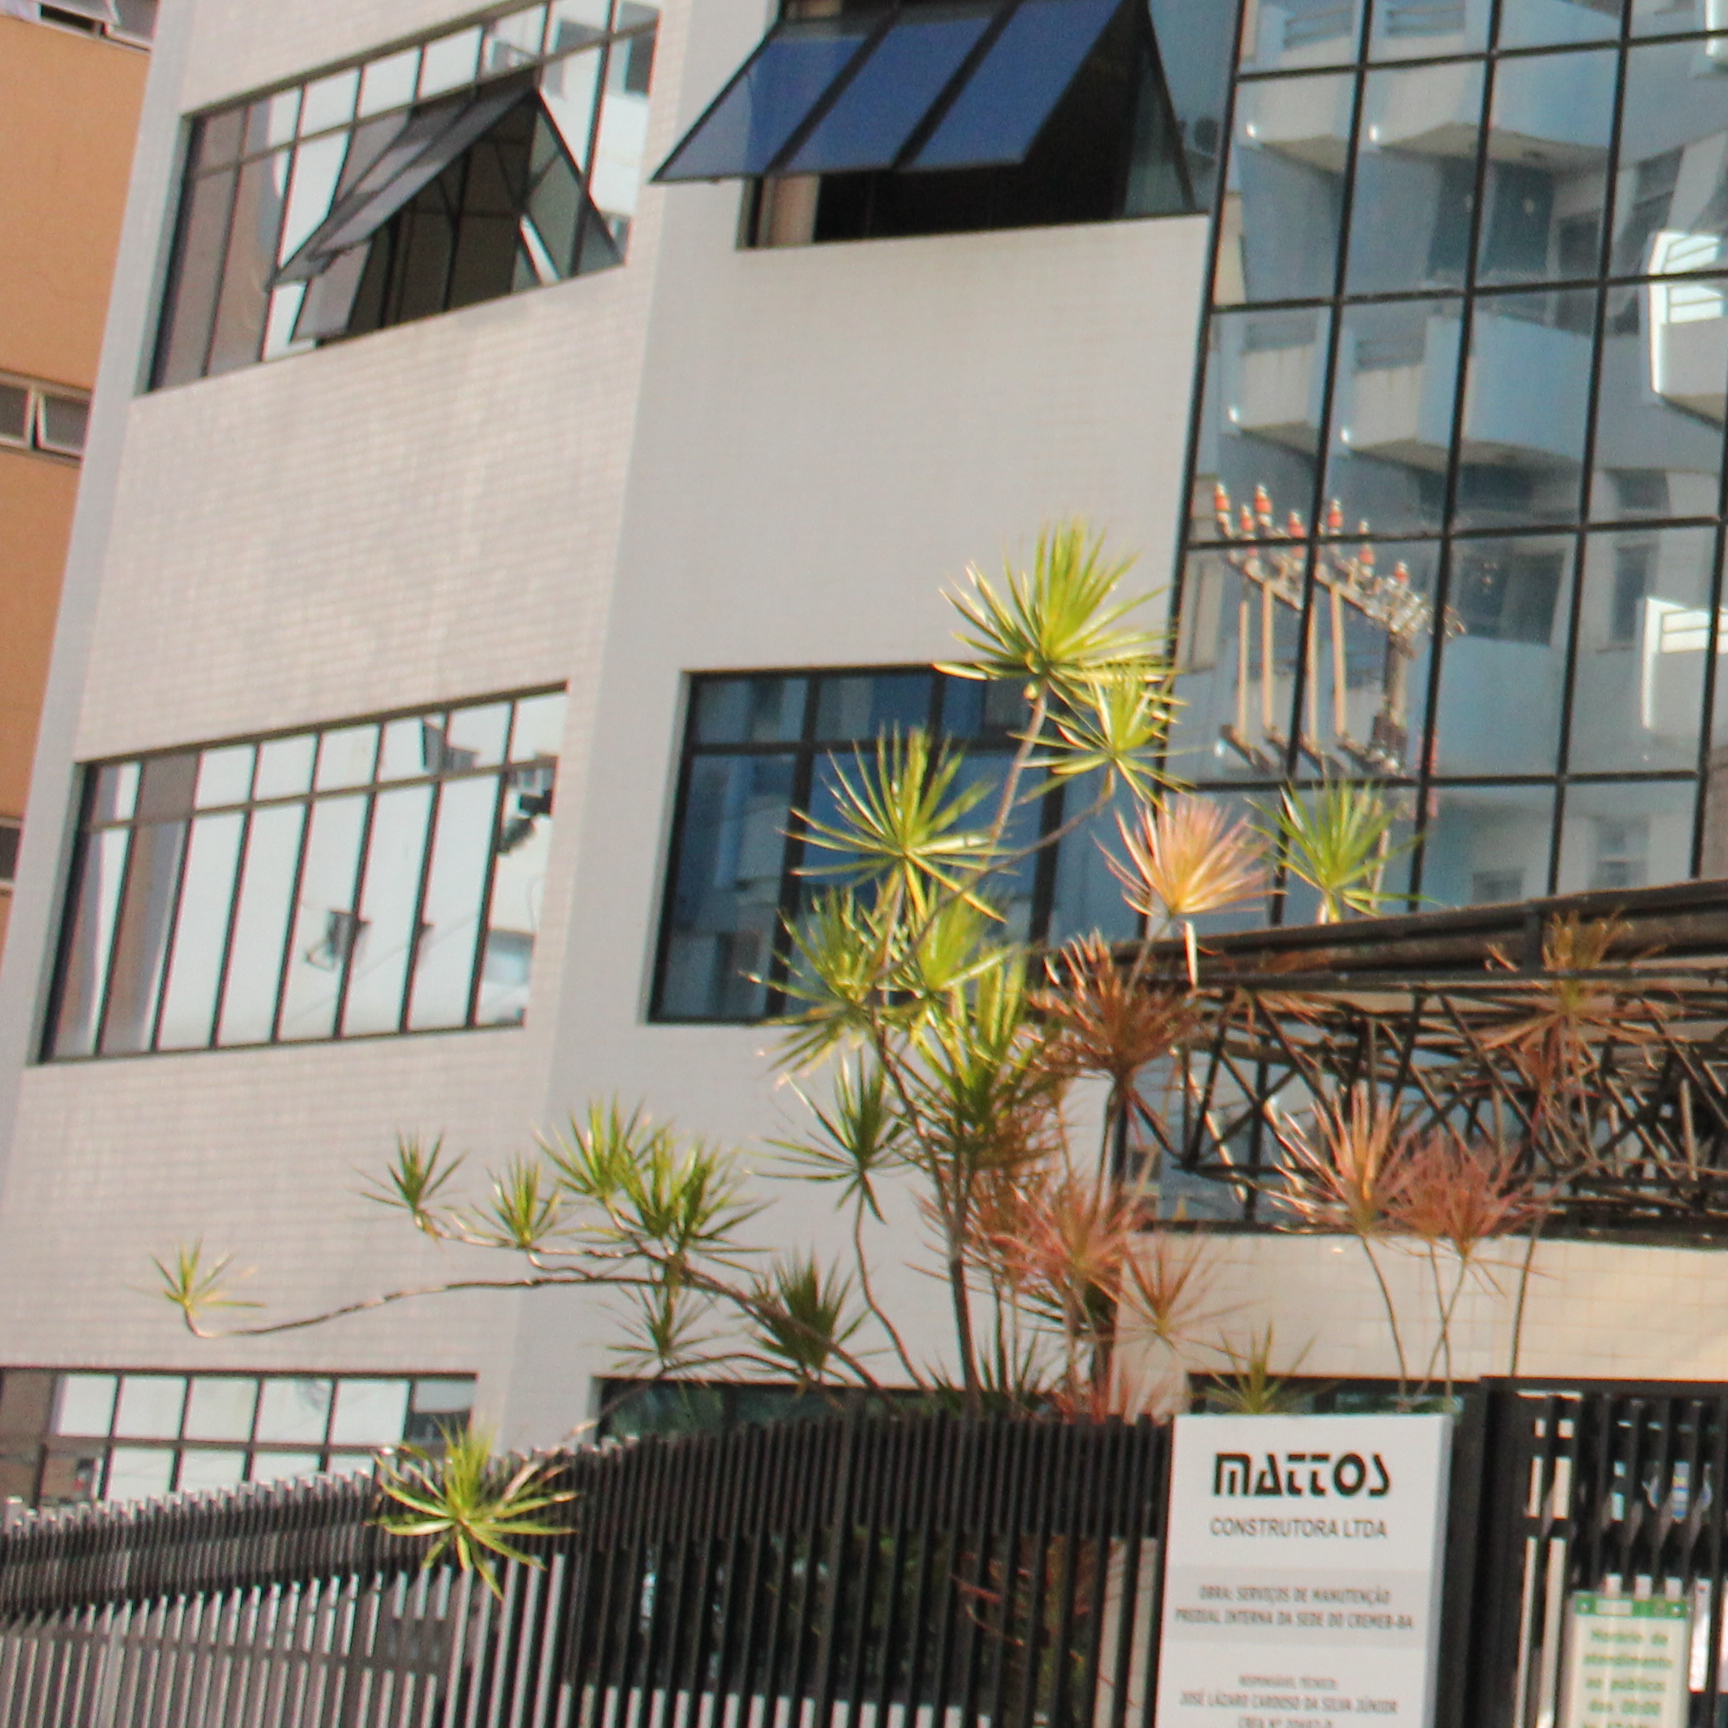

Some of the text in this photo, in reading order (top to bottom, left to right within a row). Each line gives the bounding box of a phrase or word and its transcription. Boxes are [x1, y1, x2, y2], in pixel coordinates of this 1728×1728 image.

[1212, 1452, 1391, 1498] MATTOS
[1210, 1518, 1388, 1539] CONSTRUTORA LTDA
